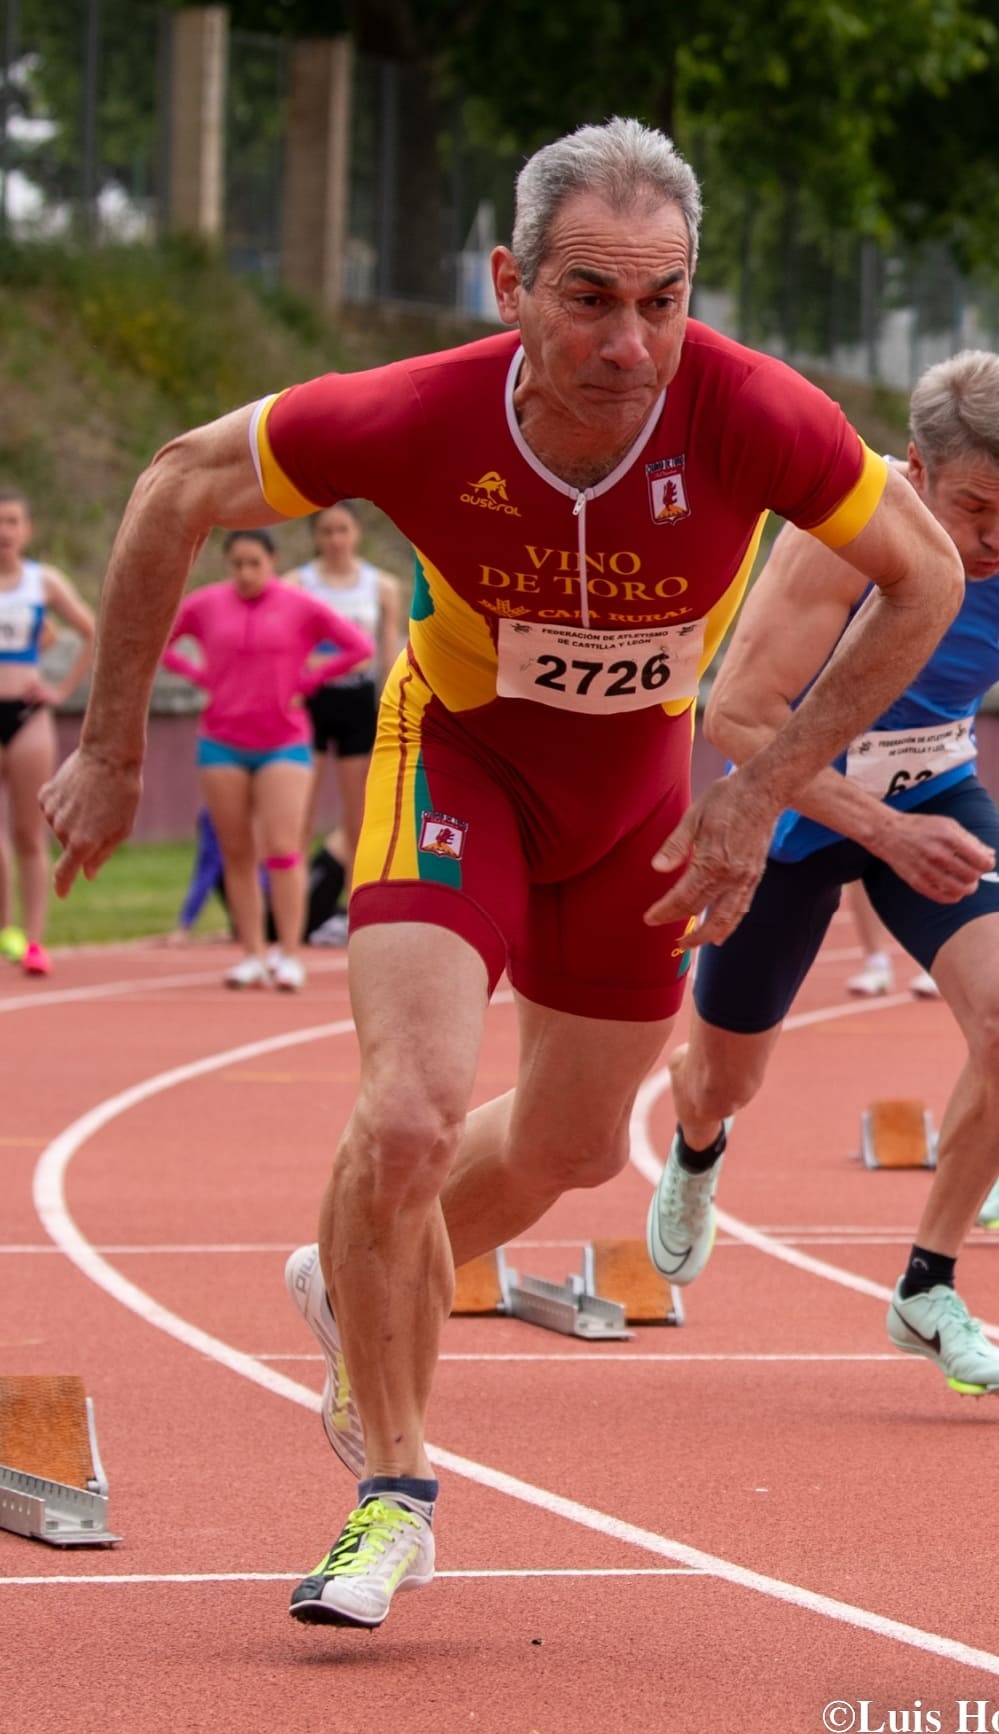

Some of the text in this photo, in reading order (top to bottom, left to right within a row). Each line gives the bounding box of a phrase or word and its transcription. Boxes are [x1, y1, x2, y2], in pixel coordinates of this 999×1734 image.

[460, 494, 522, 517] austral
[524, 545, 641, 575] VINO
[479, 565, 688, 601] DE TORO
[608, 606, 693, 623] RURAL
[542, 628, 600, 640] FEDERACIÓN
[617, 631, 668, 639] ATLETISMO
[557, 638, 569, 646] DE
[572, 641, 616, 650] CASTILLA
[535, 653, 671, 696] 2726
